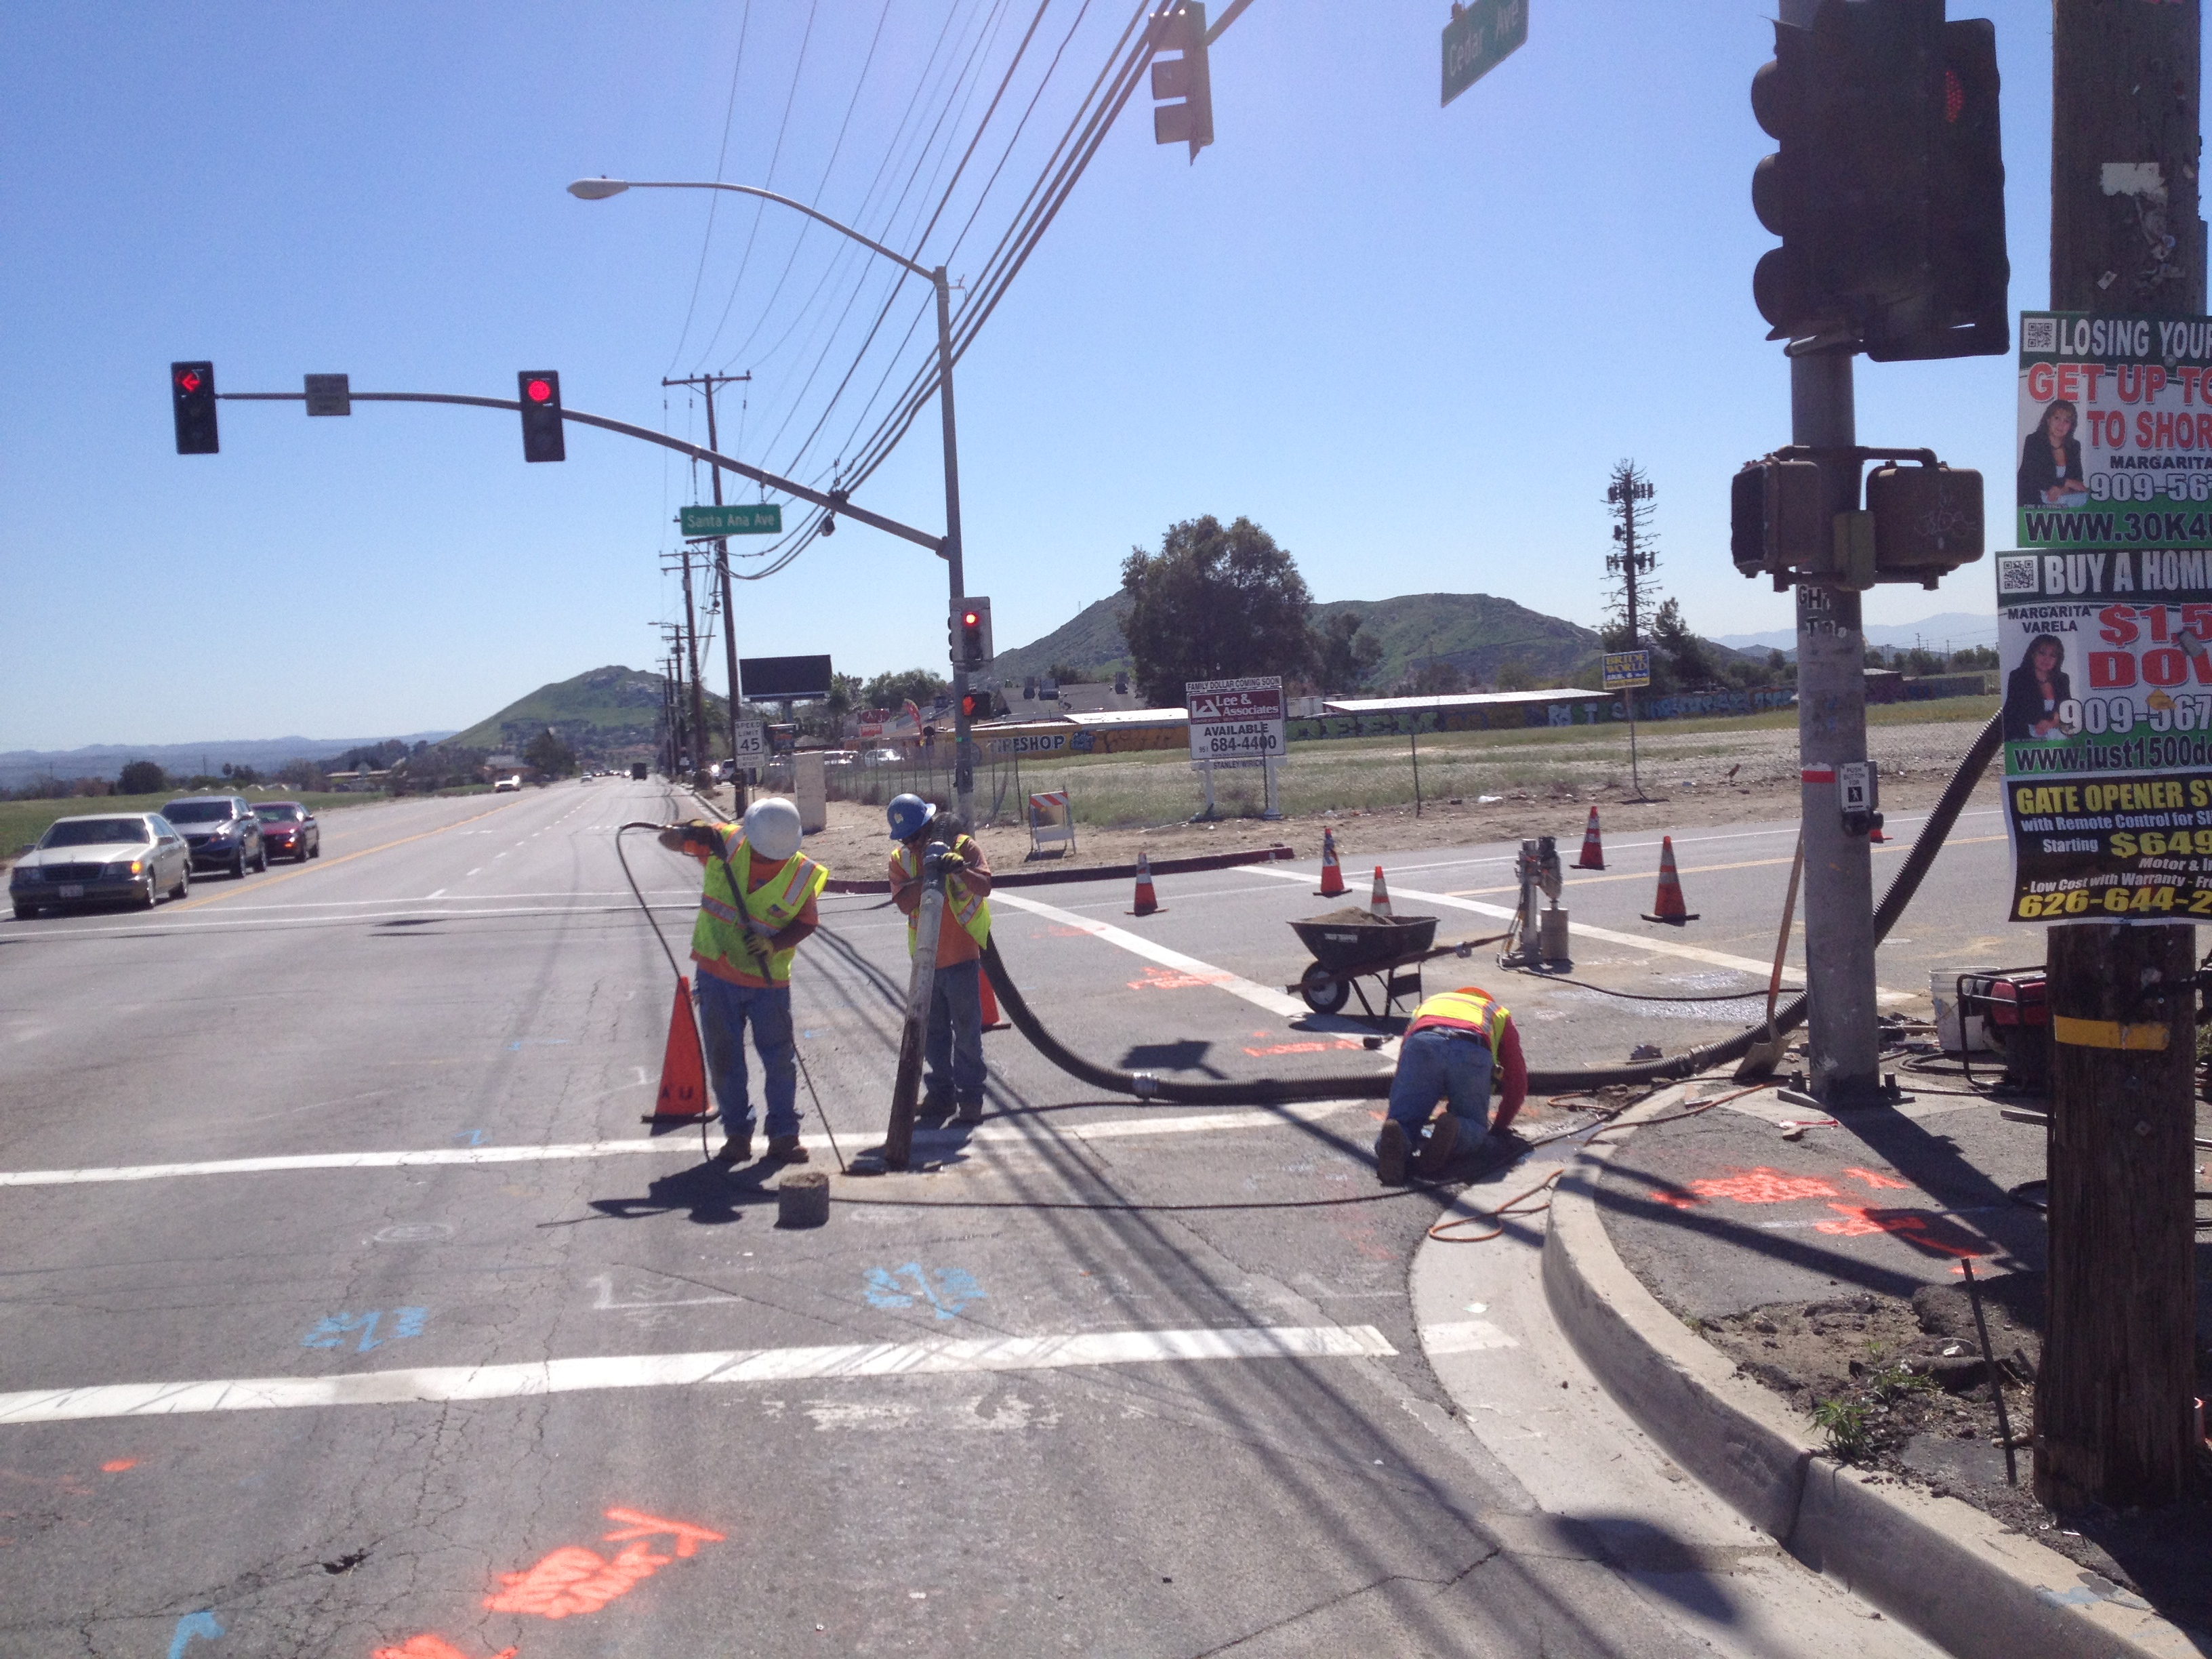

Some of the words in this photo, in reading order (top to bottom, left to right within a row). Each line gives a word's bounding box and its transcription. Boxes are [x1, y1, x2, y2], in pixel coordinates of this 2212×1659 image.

[1449, 27, 1483, 77] Cedar
[2060, 319, 2149, 357] LOSING
[2028, 362, 2105, 403] GET
[2117, 364, 2167, 405] UP
[2087, 410, 2126, 449] TO
[2110, 455, 2212, 470] MARGARITA
[2089, 472, 2212, 502] 909-56
[687, 514, 723, 529] Santa
[727, 513, 750, 527] Ana
[754, 513, 775, 527] Ave
[2024, 512, 2212, 542] WWW.30K4
[2044, 552, 2106, 595] BUY
[2113, 552, 2135, 592] A
[2008, 605, 2091, 620] MARGARITA
[2022, 620, 2078, 634] VARELA
[1187, 682, 1209, 691] FAMILY
[1210, 680, 1234, 689] DOLLAR
[1235, 678, 1261, 687] COMING
[1262, 678, 1279, 686] SOON
[1216, 695, 1238, 707] Lee
[1241, 693, 1252, 705] &
[1223, 705, 1279, 716] Associates
[1204, 723, 1269, 737] AVAILABLE
[740, 737, 760, 752] 45
[1210, 735, 1277, 752] 684-4400
[1213, 760, 1240, 769] STANLEY
[2016, 786, 2080, 814] GATE
[2085, 781, 2184, 812] OPENER
[2021, 817, 2054, 832] with
[2056, 815, 2113, 831] Remote
[2115, 813, 2170, 829] Control
[2172, 812, 2194, 826] for
[2043, 837, 2099, 853] Starting
[2110, 830, 2212, 859] $649
[2139, 857, 2187, 872] Motor
[2189, 859, 2200, 872] &
[2030, 880, 2057, 894] Low
[2059, 877, 2088, 892] Cost
[2089, 873, 2118, 887] with
[2121, 872, 2186, 887] Warranty
